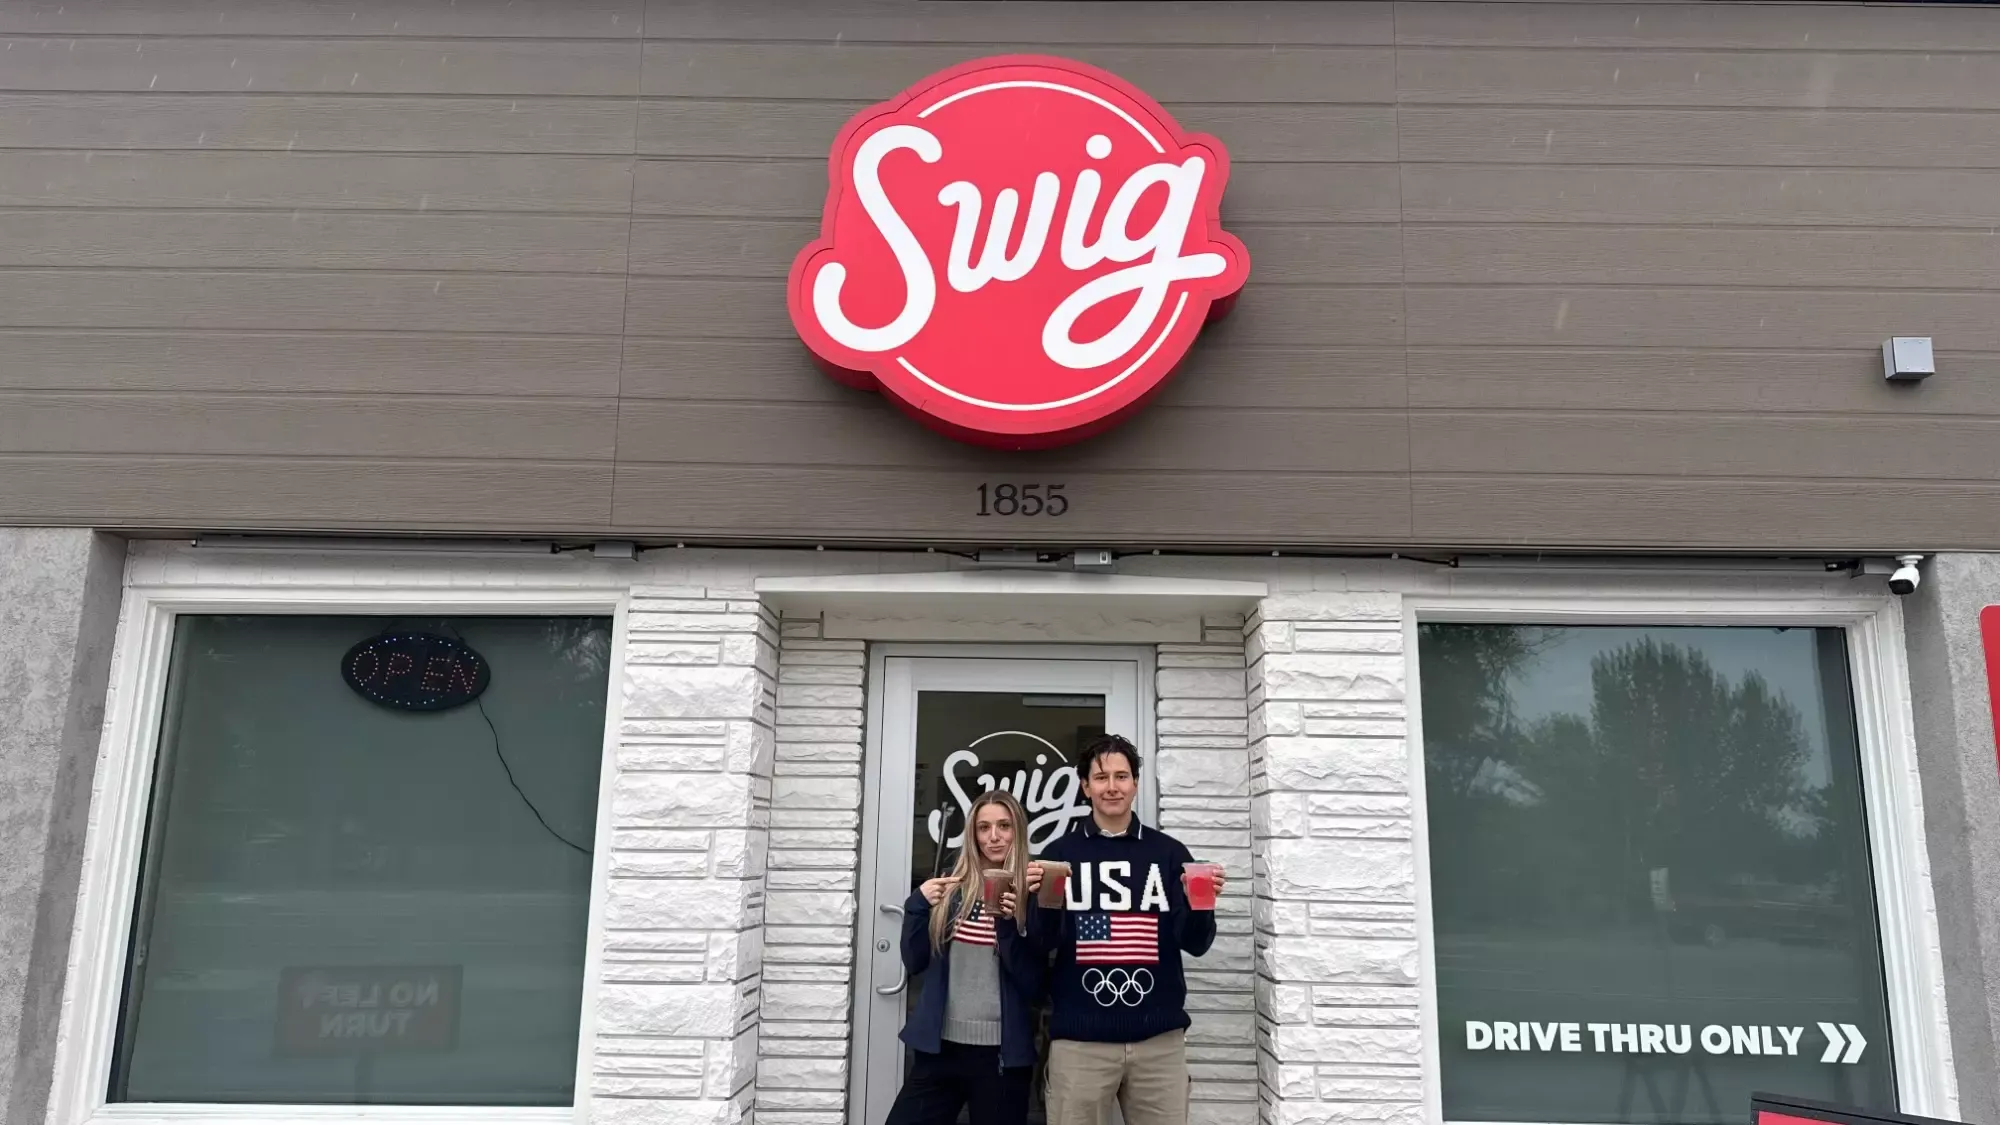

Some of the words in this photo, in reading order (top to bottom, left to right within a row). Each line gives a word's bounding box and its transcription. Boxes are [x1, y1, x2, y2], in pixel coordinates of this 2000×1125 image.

[813, 125, 1226, 368] Swig
[975, 483, 1069, 516] 1855
[353, 651, 479, 694] OPEN
[1065, 861, 1170, 911] USA
[1466, 1021, 1582, 1052] DRIVE
[1588, 1023, 1692, 1054] THRU
[1701, 1024, 1805, 1056] ONLY
